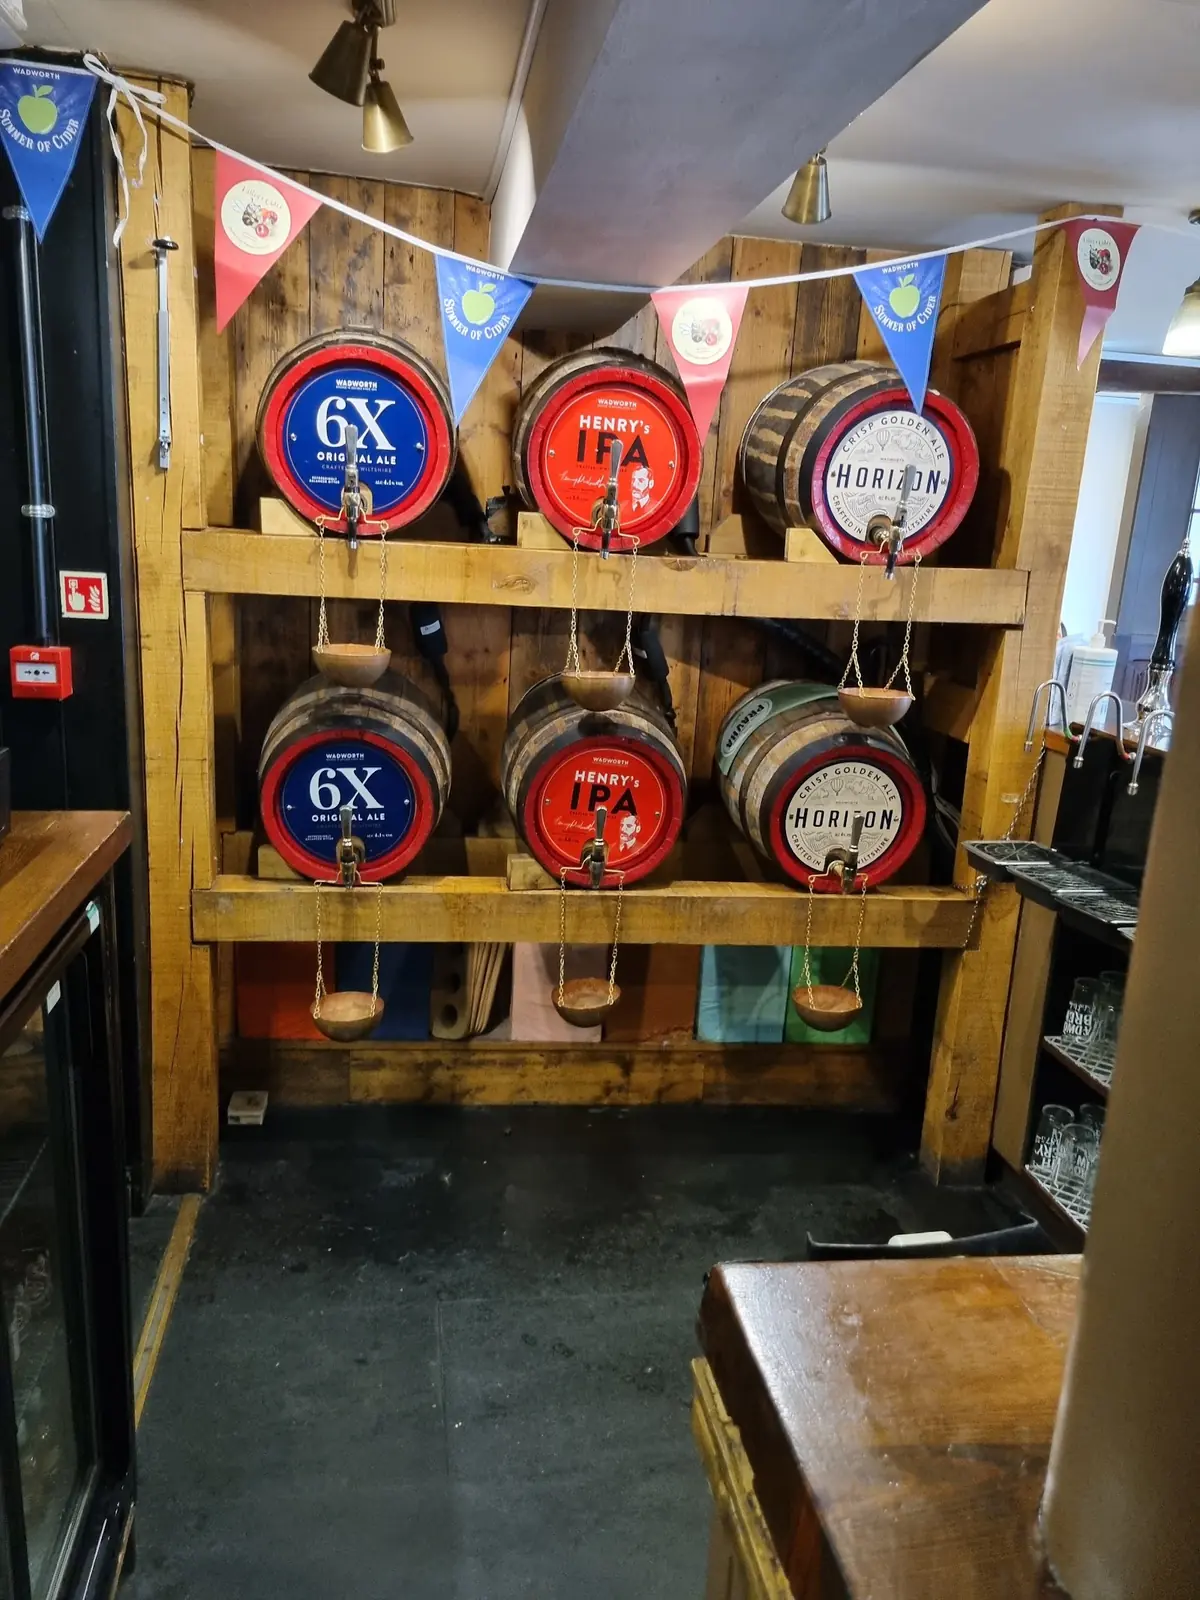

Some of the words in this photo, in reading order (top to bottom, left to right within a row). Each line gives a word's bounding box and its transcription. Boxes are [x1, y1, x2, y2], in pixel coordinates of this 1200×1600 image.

[12, 67, 60, 80] WADWORTH
[465, 263, 504, 281] WADWORTH
[881, 262, 919, 274] WADWORTH
[336, 378, 378, 388] WADWORTH
[598, 398, 637, 408] WADWORTH
[316, 396, 396, 451] 6X
[842, 422, 874, 453] CRISP
[881, 416, 930, 436] GOLDEN
[930, 438, 945, 460] ALE
[376, 455, 397, 465] ALE
[832, 495, 854, 528] CRAFTED
[854, 525, 863, 535] IN
[593, 757, 629, 766] WADWORTH
[309, 767, 384, 811] 6X
[799, 772, 828, 799] CRISP
[834, 766, 882, 783] GOLDEN
[882, 784, 896, 802] ALE
[570, 782, 638, 815] IPA
[367, 813, 385, 821] ALE
[794, 808, 894, 830] HORION
[791, 834, 812, 860] CRAFTED
[812, 858, 822, 867] IN
